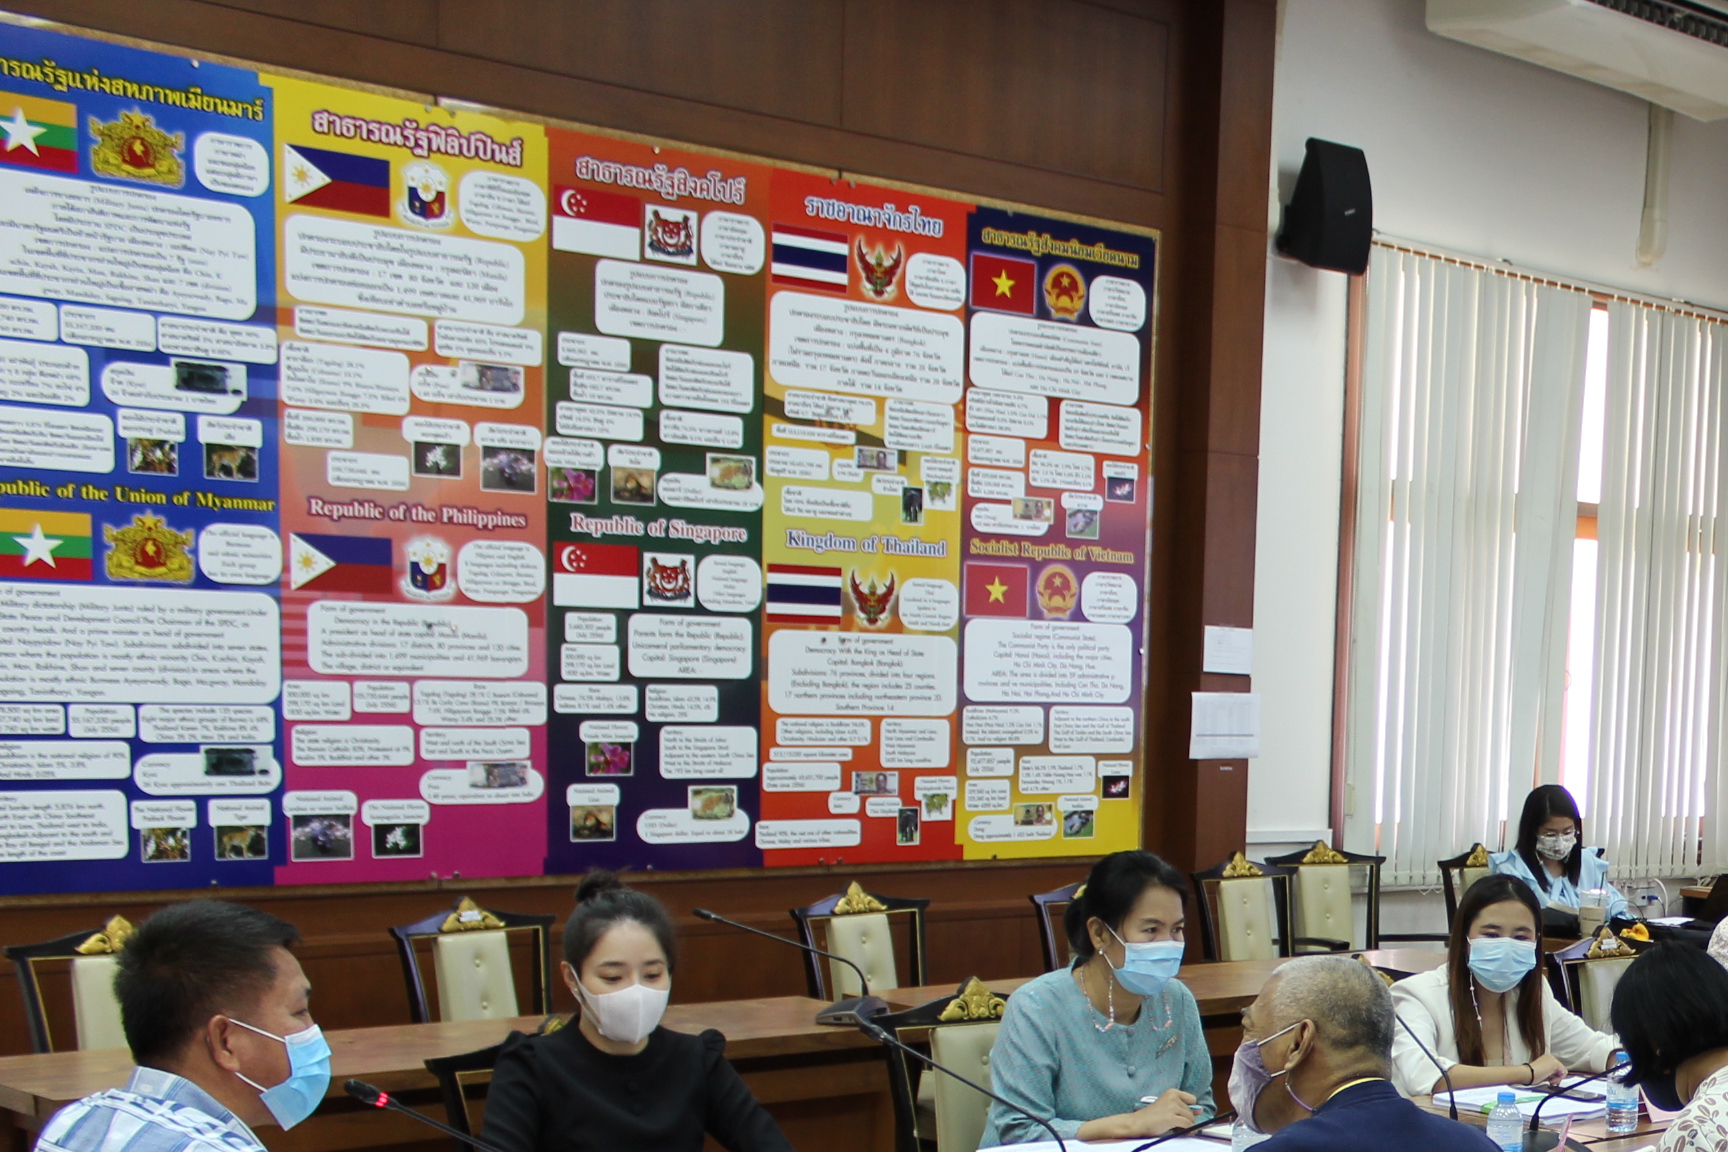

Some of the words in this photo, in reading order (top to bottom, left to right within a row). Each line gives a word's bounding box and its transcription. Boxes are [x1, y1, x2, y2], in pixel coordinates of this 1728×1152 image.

[312, 110, 523, 167] สาธารณรัฐฟิลิปปินส์
[575, 157, 746, 205] สาธารณรัฐสิงคโปร์
[804, 196, 943, 237] ราชอาณาจักรไทย
[982, 227, 1139, 269] สาธารณรัฐสังคมนิยมเวียดนาม
[56, 484, 75, 499] of
[81, 485, 108, 501] the
[115, 486, 167, 504] Union
[172, 491, 190, 506] of
[196, 491, 275, 511] Myanmar
[308, 496, 383, 521] Republic
[389, 504, 407, 520] of
[411, 506, 436, 523] the
[441, 507, 527, 529] Philippines
[570, 513, 644, 537] Republic
[648, 518, 665, 536] of
[669, 519, 747, 544] Singapore
[785, 529, 856, 553] Kingdom
[861, 535, 877, 552] of
[881, 536, 947, 557] Thailand
[970, 538, 1019, 556] Socialist
[1021, 542, 1071, 560] Republic
[1073, 545, 1086, 560] of
[1088, 547, 1134, 564] Vietnam
